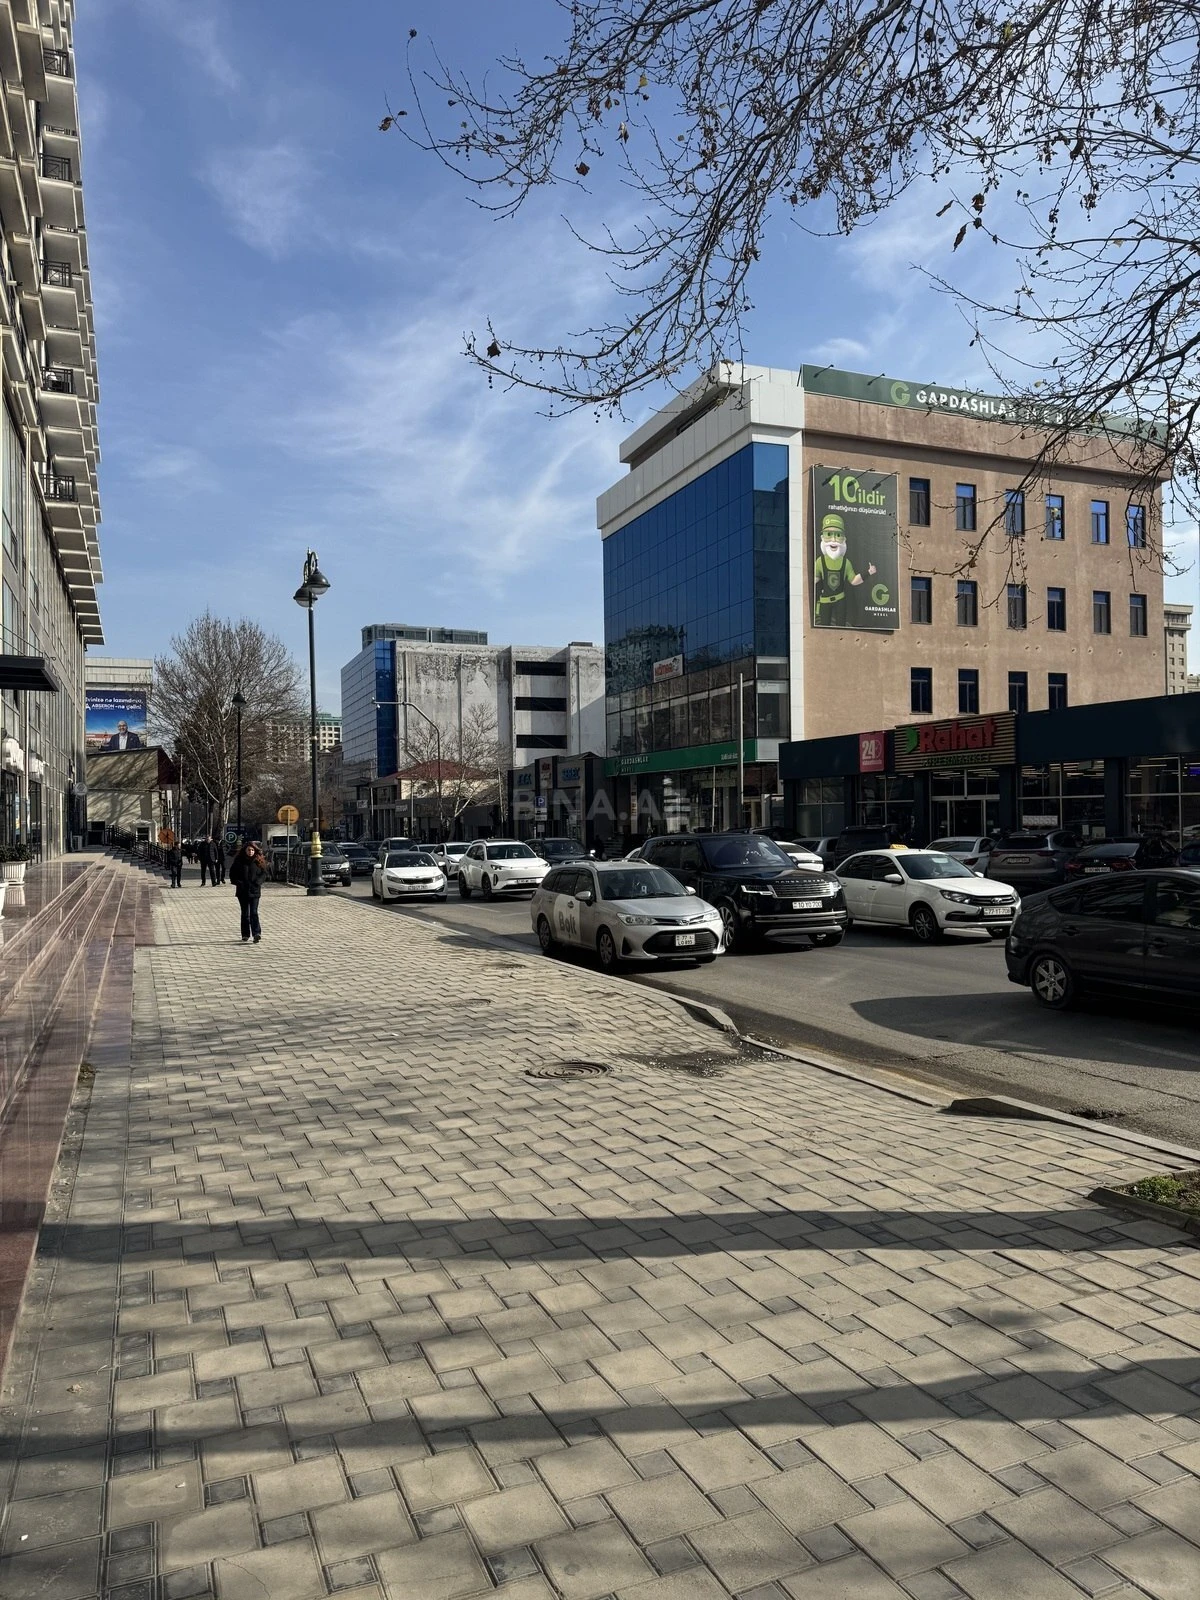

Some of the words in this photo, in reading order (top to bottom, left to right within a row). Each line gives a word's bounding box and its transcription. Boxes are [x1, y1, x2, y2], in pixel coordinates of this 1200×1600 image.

[828, 474, 860, 503] 10
[858, 488, 886, 506] ildir
[919, 717, 995, 753] Rahat
[862, 739, 876, 760] 24
[558, 910, 577, 935] Bolt
